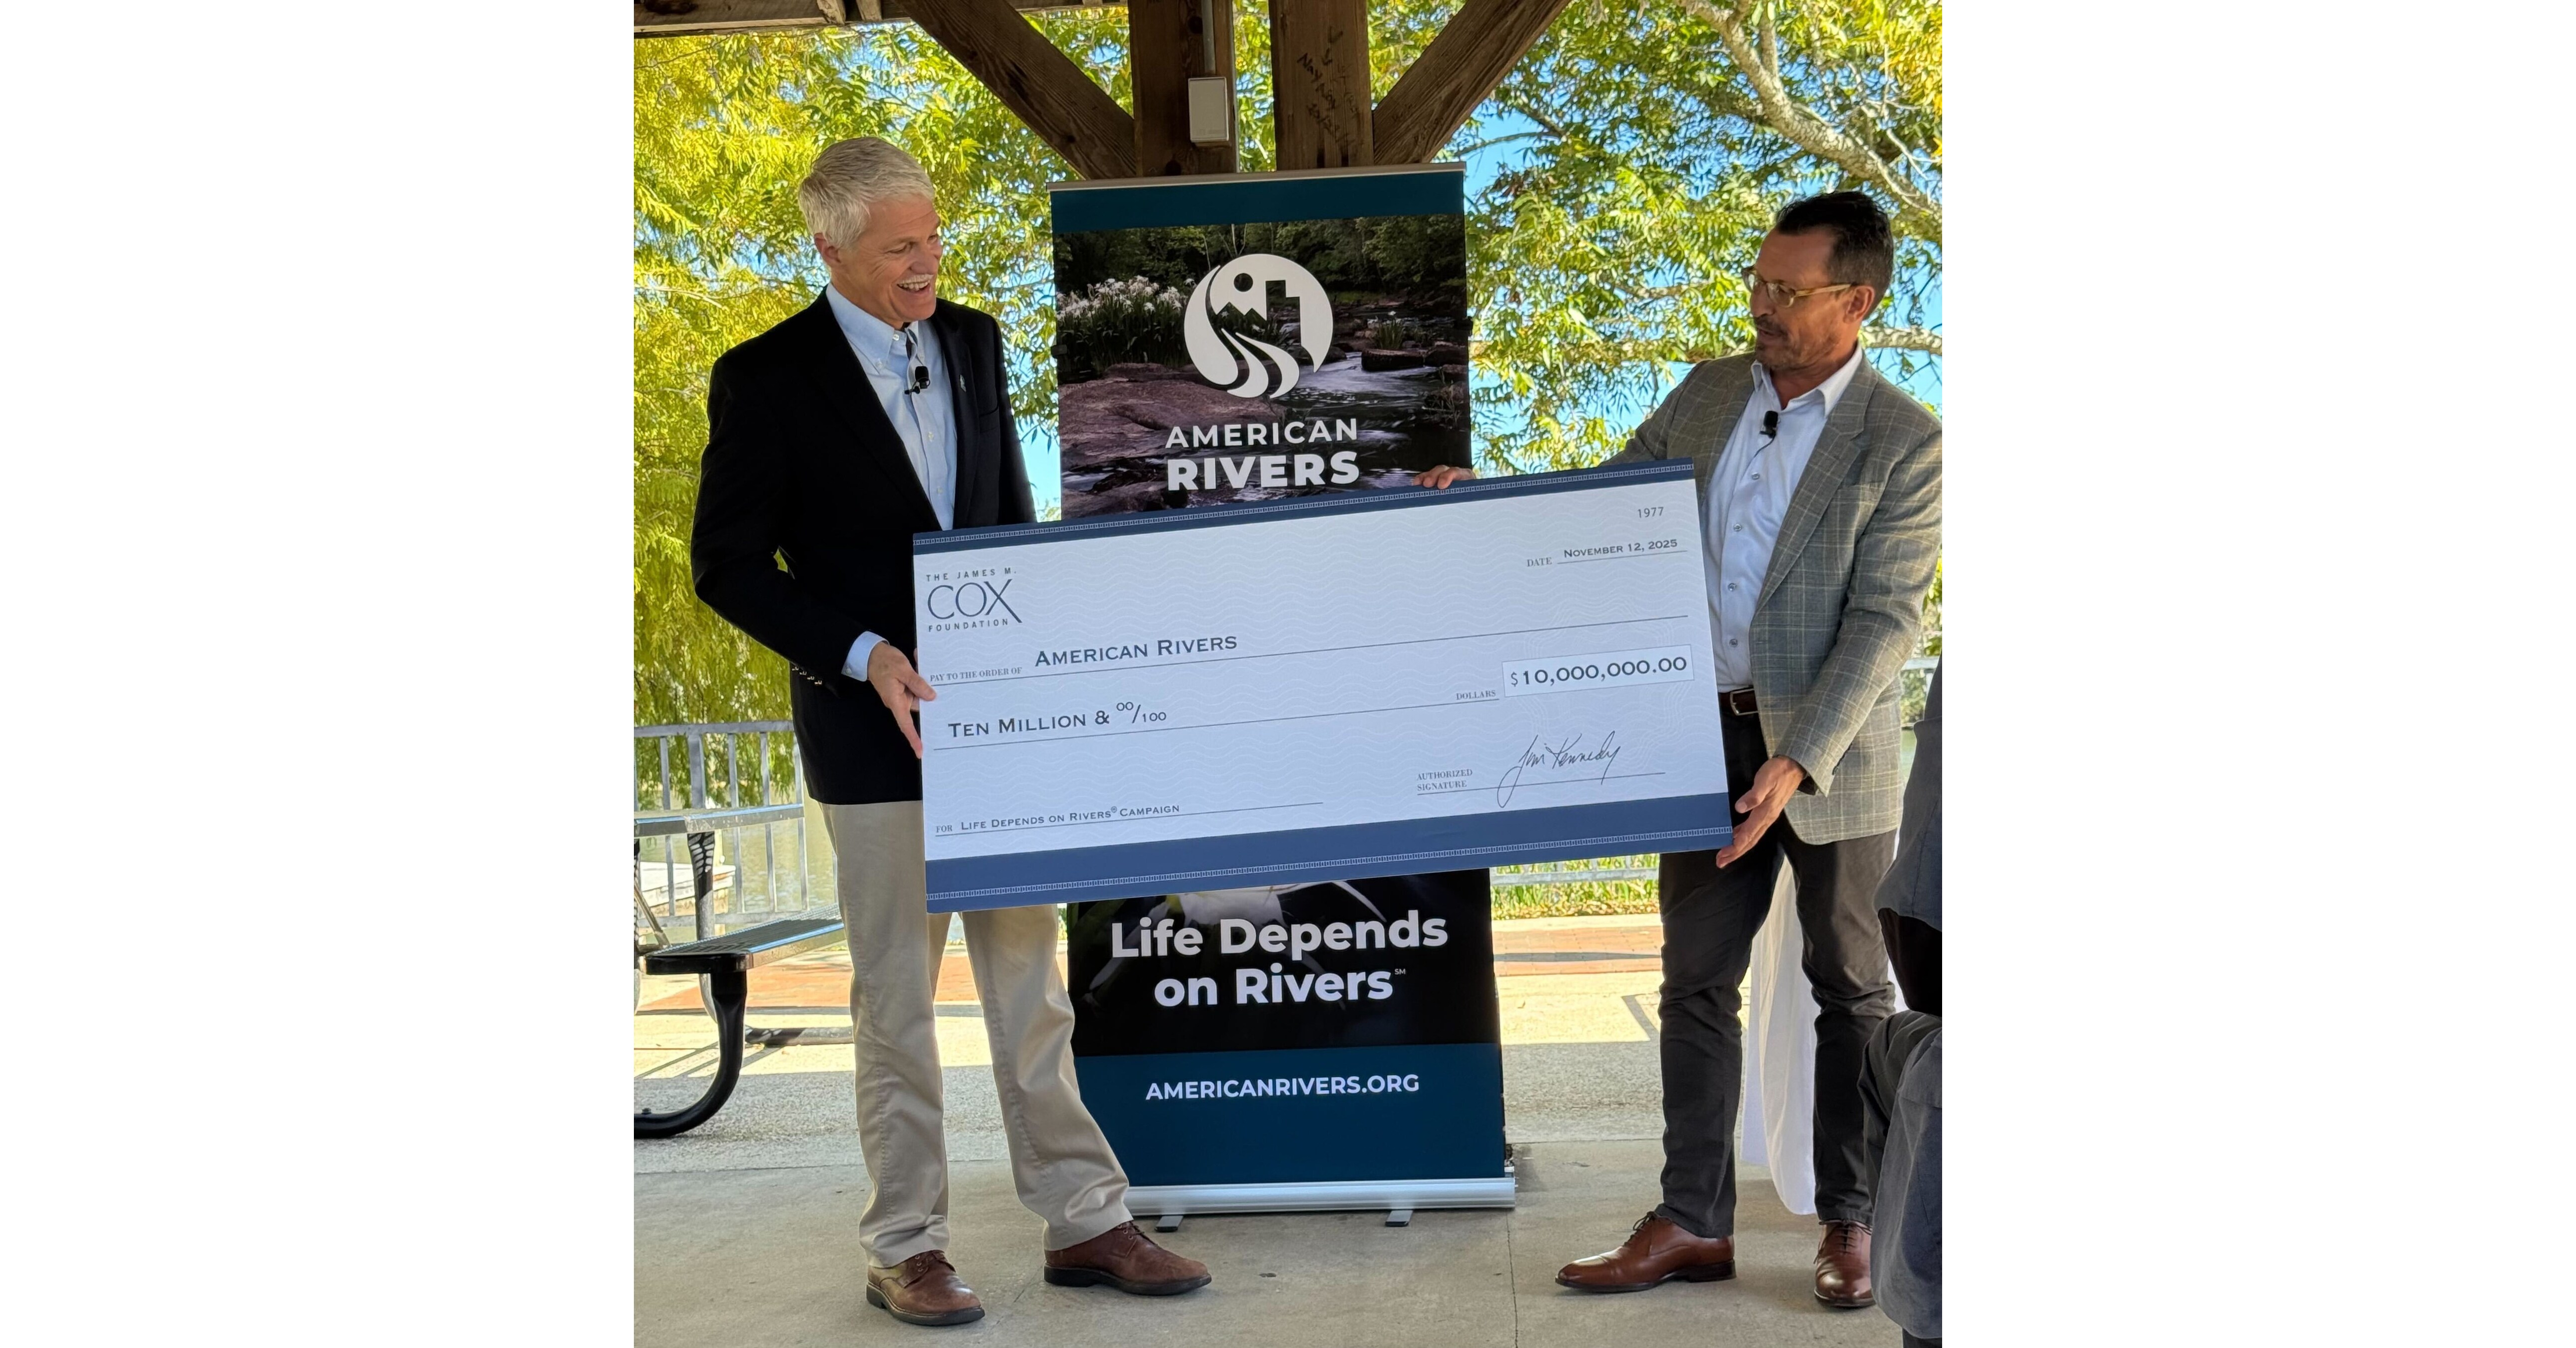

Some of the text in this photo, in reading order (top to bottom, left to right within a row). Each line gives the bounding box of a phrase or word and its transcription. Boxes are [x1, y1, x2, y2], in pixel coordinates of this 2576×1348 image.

[1165, 418, 1357, 449] AMERICAN
[1167, 451, 1359, 491] RIVERS
[1637, 506, 1664, 518] 1977
[1527, 557, 1552, 567] DATE
[1628, 542, 1644, 552] 12,
[1648, 539, 1678, 550] 2025
[926, 573, 949, 582] THE
[957, 568, 996, 579] JAMES
[927, 578, 1023, 624] COX
[928, 619, 1009, 632] FOUNDATION
[960, 671, 978, 679] THE
[979, 668, 1010, 678] ORDER
[1034, 644, 1148, 667] AMERICAN
[1157, 636, 1237, 656] RIVERS
[1456, 656, 1687, 700] DOLLARS $10,000,000.00
[948, 723, 989, 738] TEN
[999, 714, 1086, 734] MILLION
[1094, 710, 1109, 725] &
[1417, 769, 1473, 780] AUTHORIZED
[1417, 780, 1468, 792] SIGNATURE
[936, 825, 953, 833] FOR
[991, 816, 1044, 828] DEPENDS
[1119, 805, 1180, 817] CAMPAIGN
[1111, 909, 1448, 961] Life Depends
[1154, 977, 1218, 1007] on
[1236, 962, 1393, 1004] Rivers
[1145, 1074, 1419, 1100] AMERICANRIVERS.ORG
